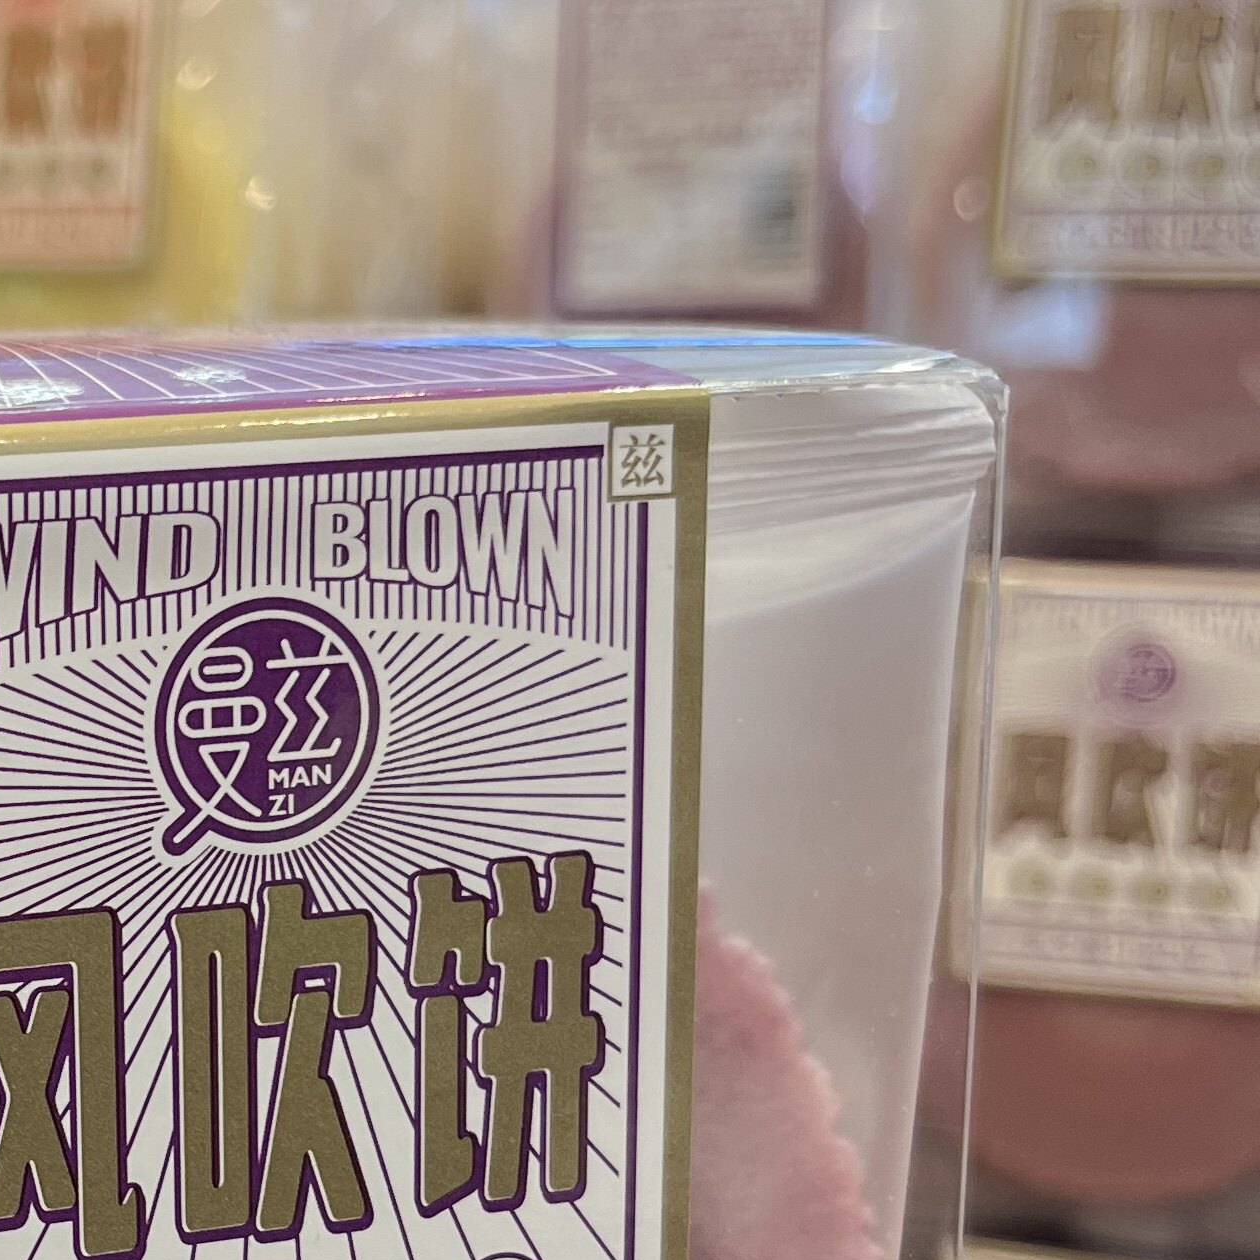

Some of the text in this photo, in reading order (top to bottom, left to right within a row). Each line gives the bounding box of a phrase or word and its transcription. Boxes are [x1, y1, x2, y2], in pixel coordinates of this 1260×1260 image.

[619, 433, 666, 489] 兹
[312, 486, 576, 619] BLOWN
[267, 763, 333, 790] MAN
[268, 793, 295, 817] ZI
